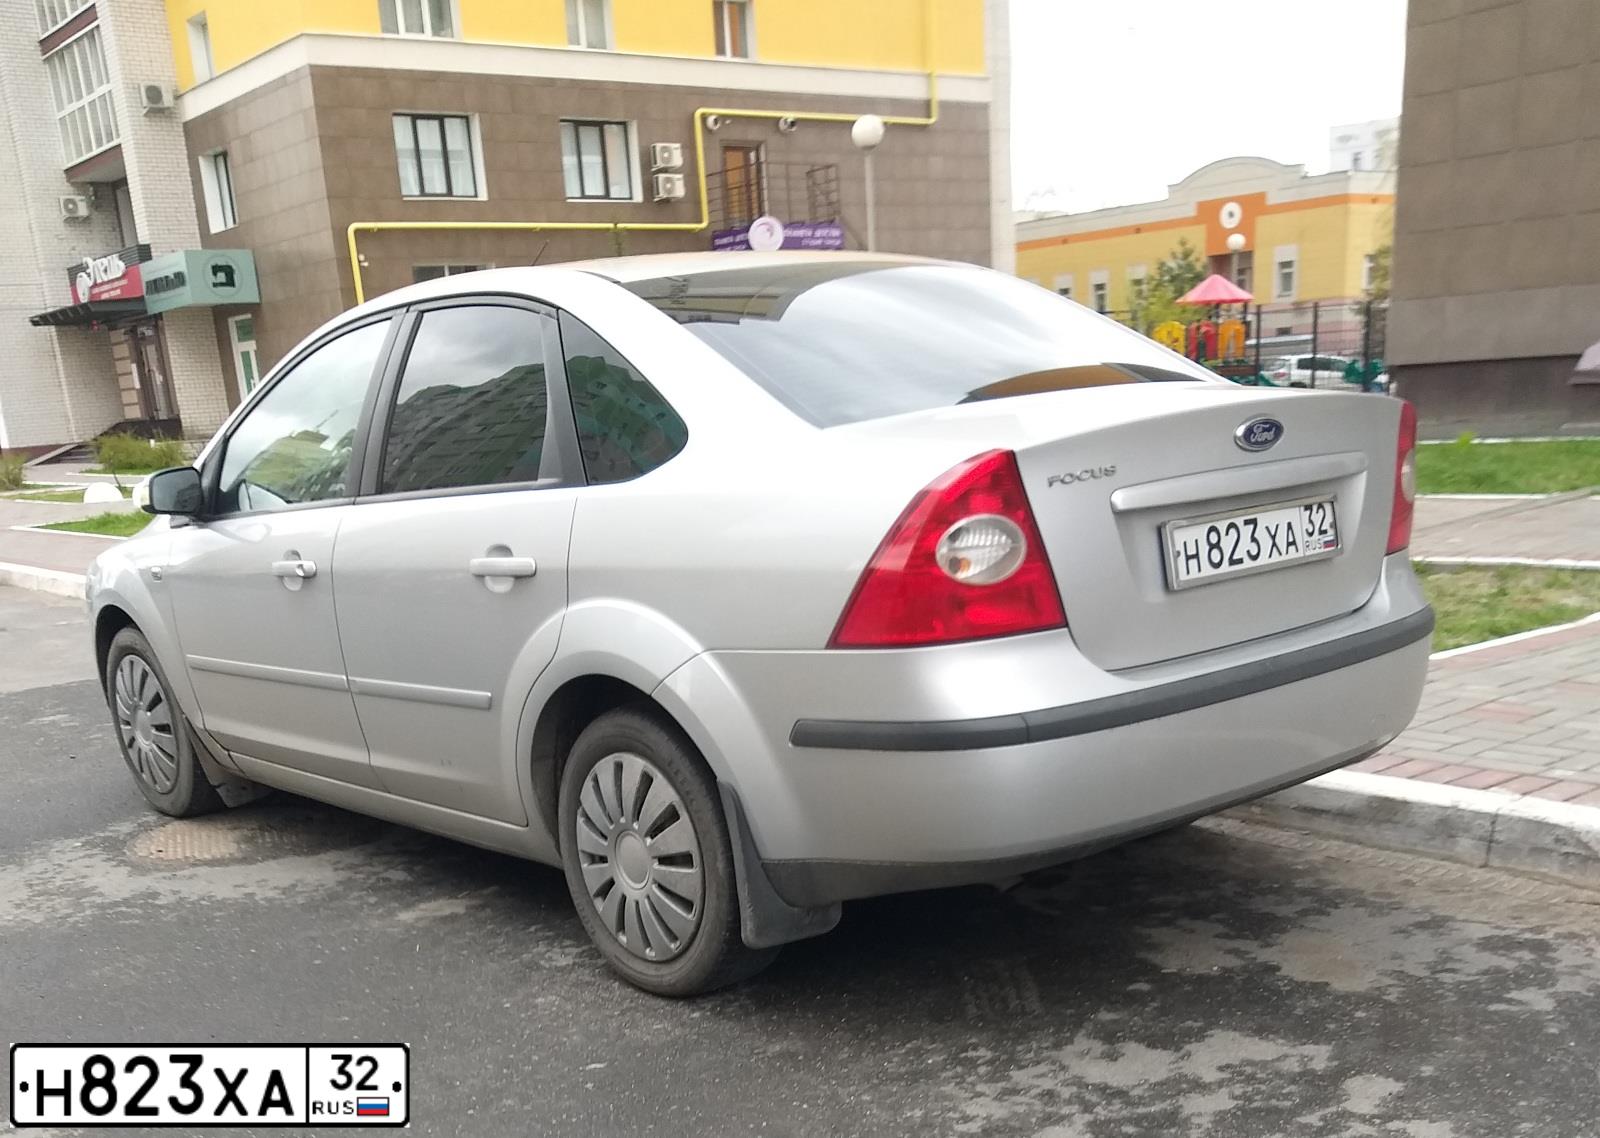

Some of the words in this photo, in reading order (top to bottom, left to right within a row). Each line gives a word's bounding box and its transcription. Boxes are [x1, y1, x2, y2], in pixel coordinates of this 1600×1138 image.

[1249, 424, 1277, 444] Ford
[1047, 465, 1117, 488] FOCUS
[1303, 503, 1328, 537] 32
[1305, 538, 1323, 551] RUS
